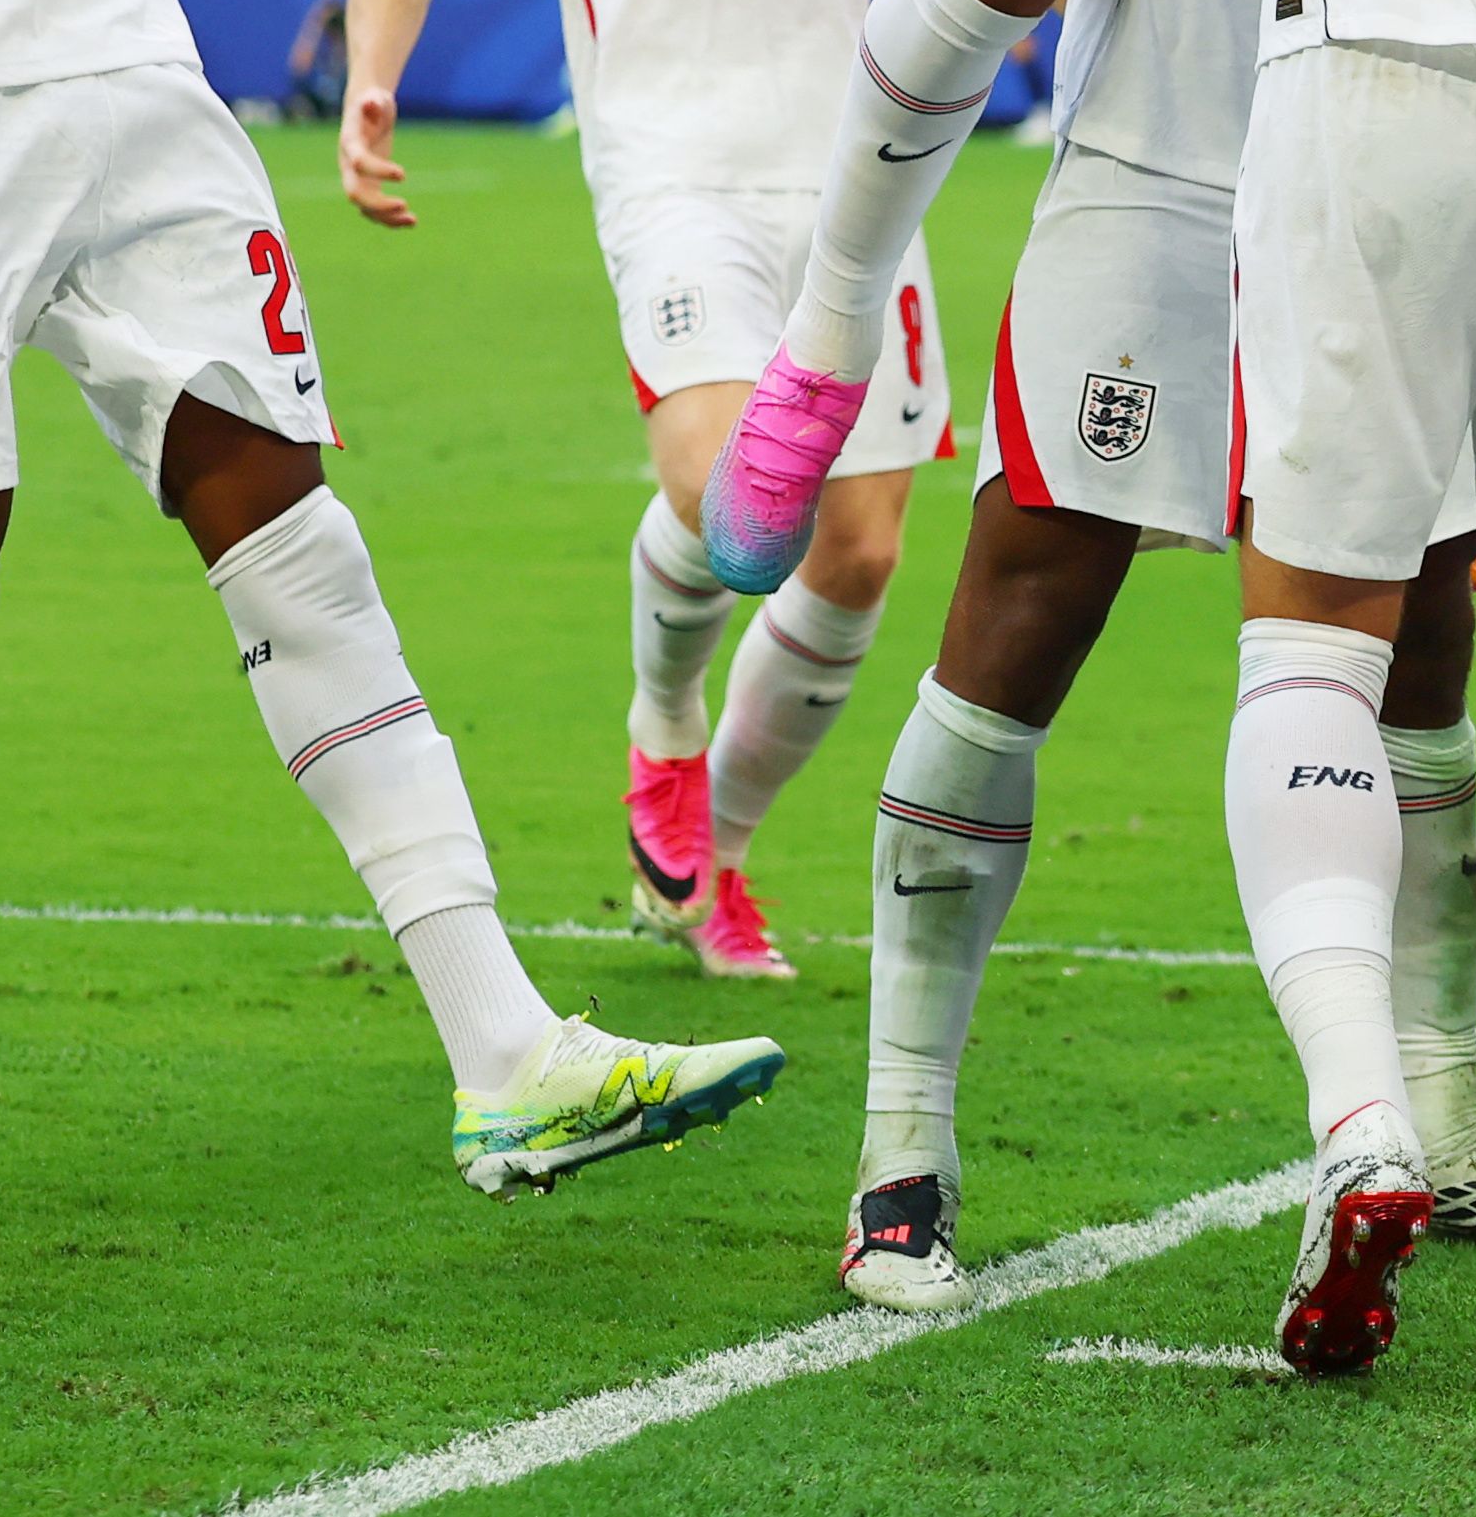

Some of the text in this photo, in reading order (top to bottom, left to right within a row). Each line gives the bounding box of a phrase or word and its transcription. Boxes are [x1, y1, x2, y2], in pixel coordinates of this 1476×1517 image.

[247, 229, 309, 355] 2
[898, 284, 923, 387] 8
[240, 639, 272, 673] EN
[1288, 765, 1375, 793] ENG
